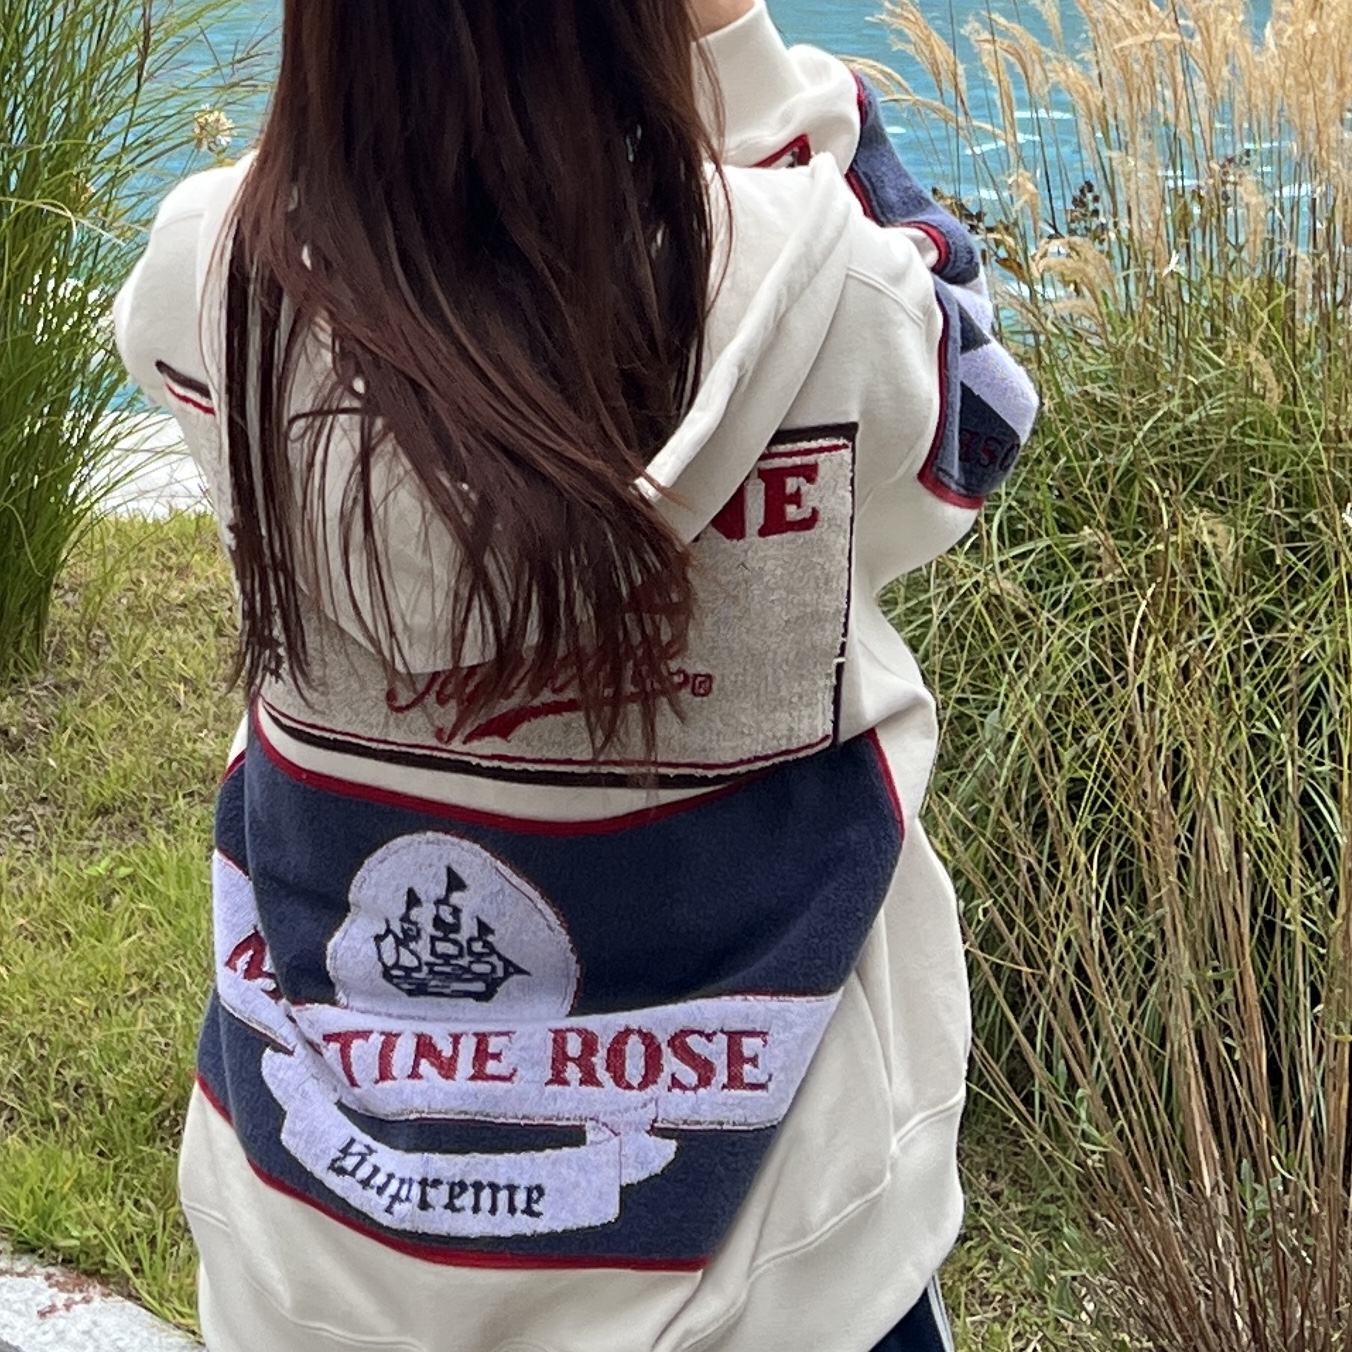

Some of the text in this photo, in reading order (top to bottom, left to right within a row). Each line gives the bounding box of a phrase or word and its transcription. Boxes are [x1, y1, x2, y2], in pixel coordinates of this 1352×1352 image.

[322, 1026, 773, 1093] TINE ROSE
[327, 1137, 546, 1218] Supreme
